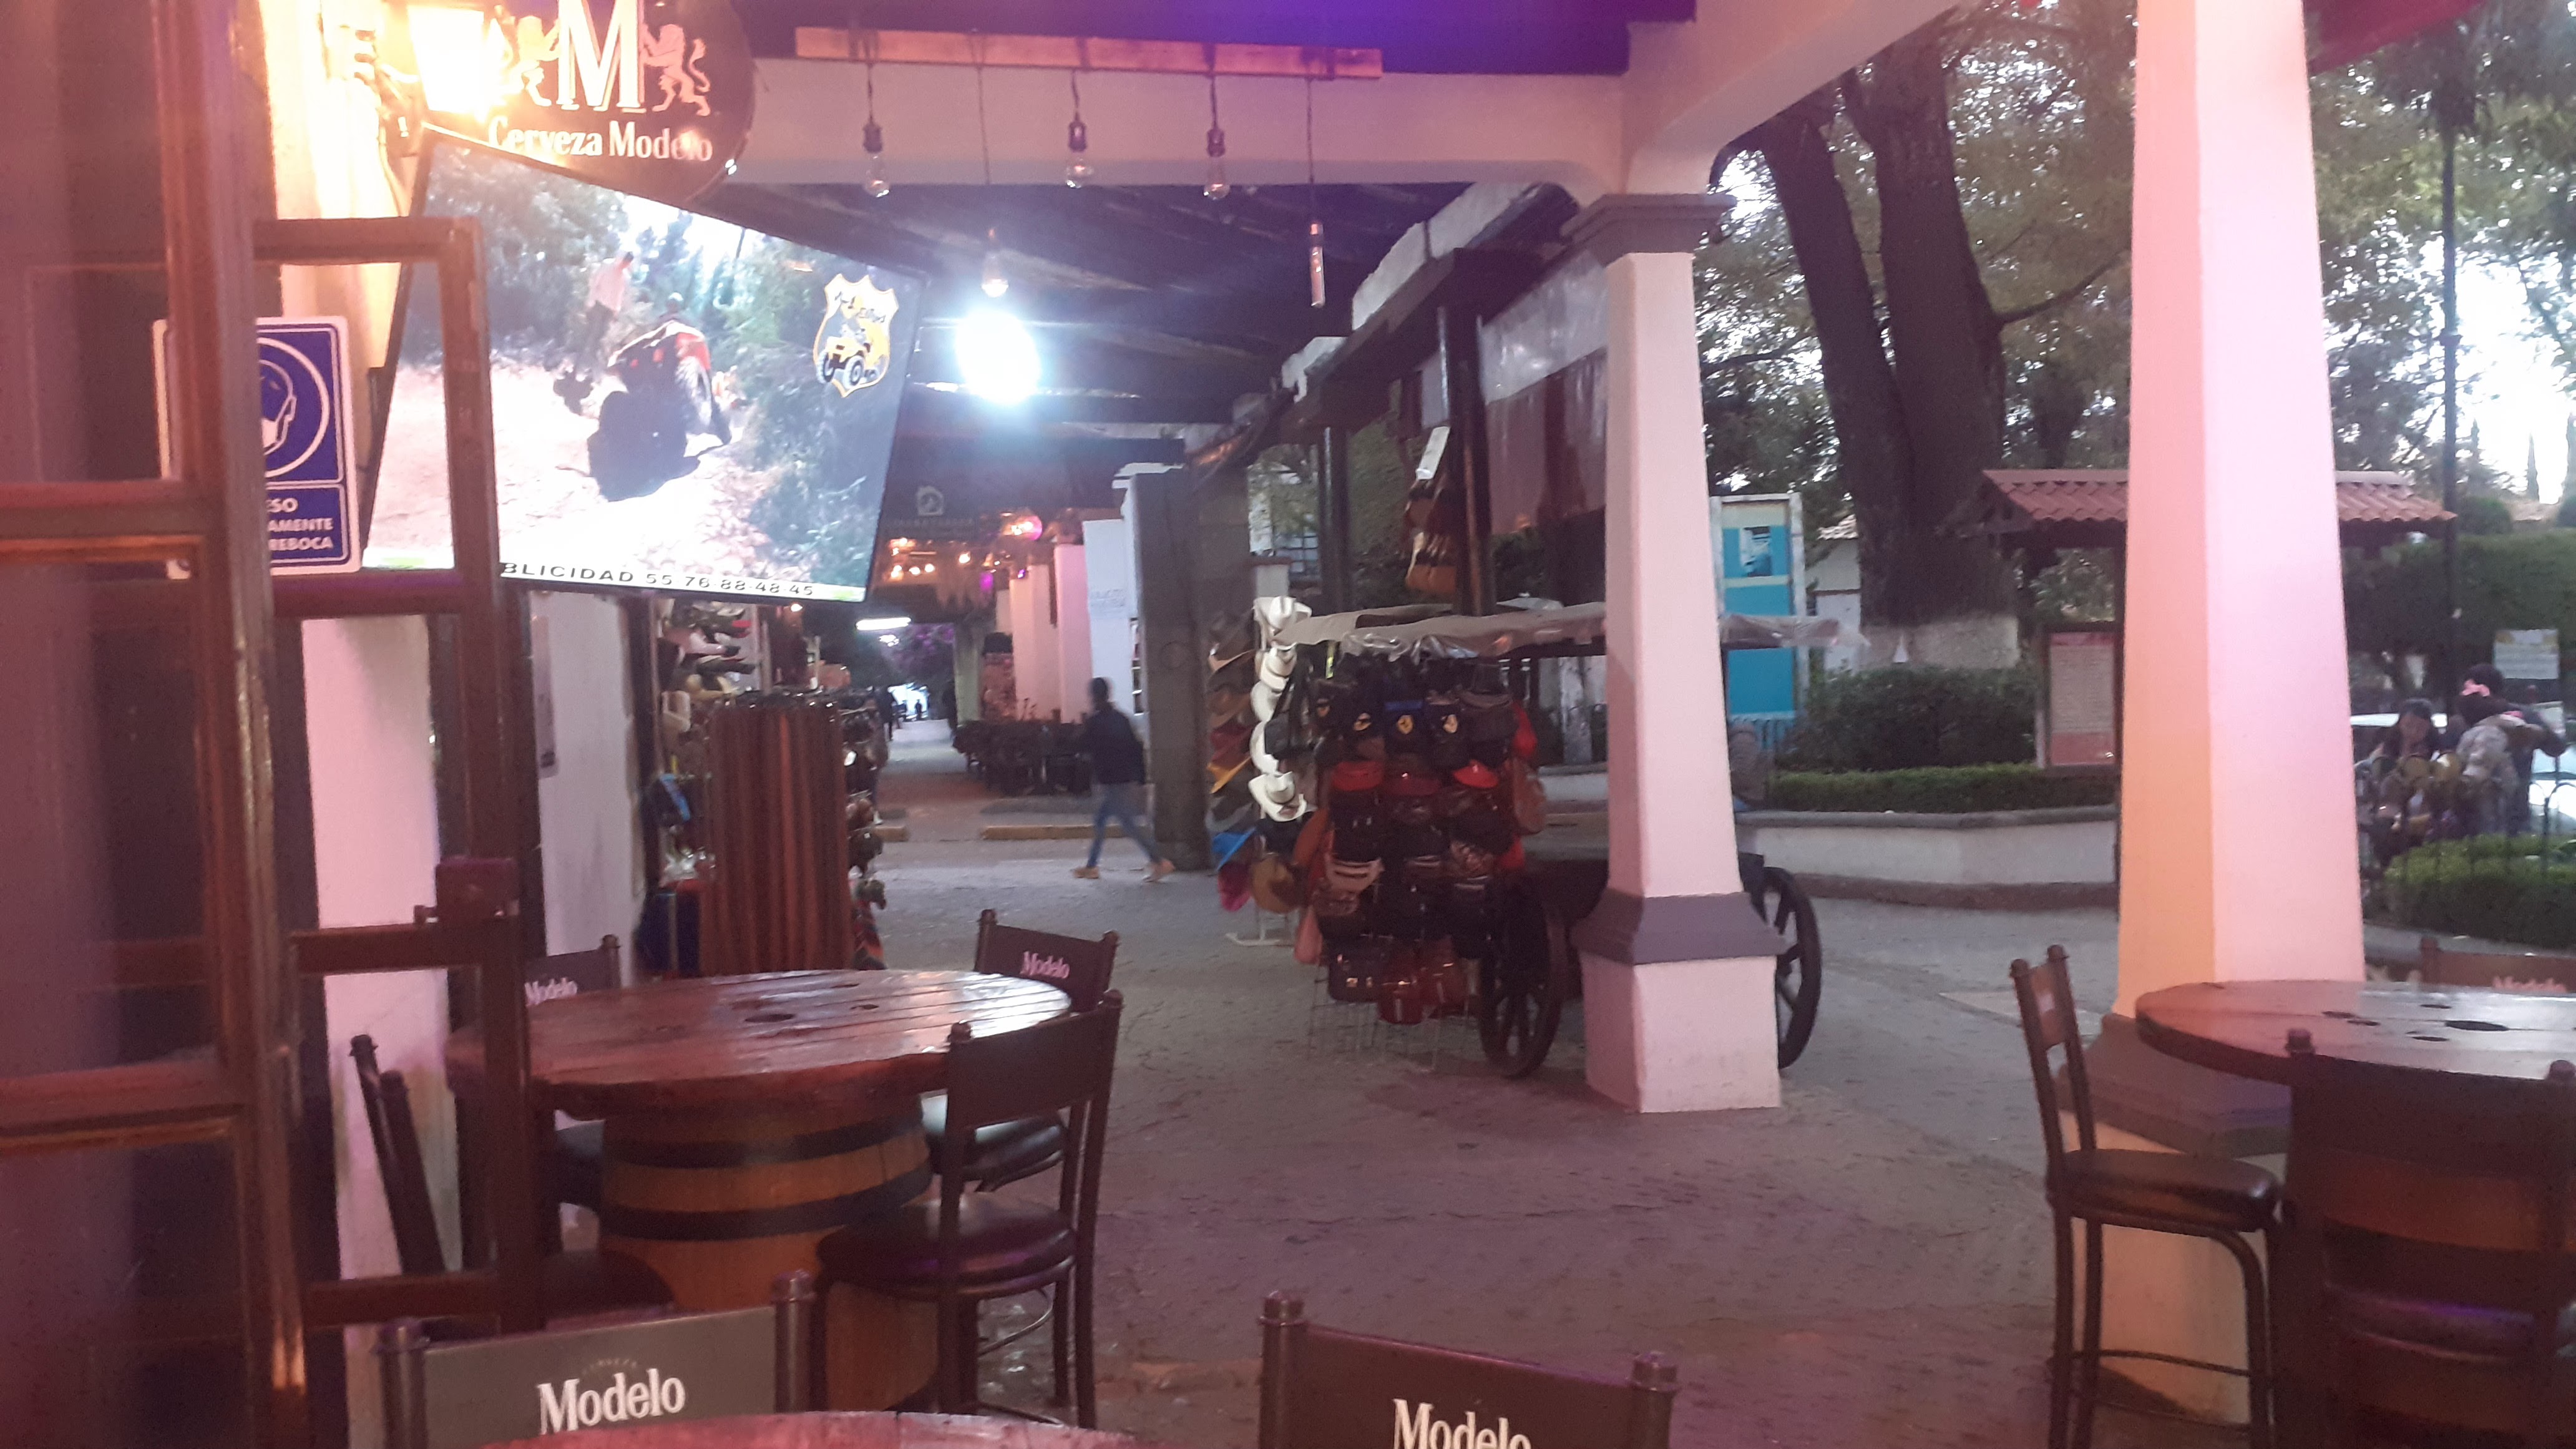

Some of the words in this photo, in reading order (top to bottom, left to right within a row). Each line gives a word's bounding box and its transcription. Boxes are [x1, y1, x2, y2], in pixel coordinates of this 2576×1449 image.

[556, 0, 646, 114] M
[488, 116, 603, 157] Cerveza
[609, 120, 713, 161] Modelo
[1019, 950, 1070, 979] Modelo
[537, 1367, 686, 1435] Modelo
